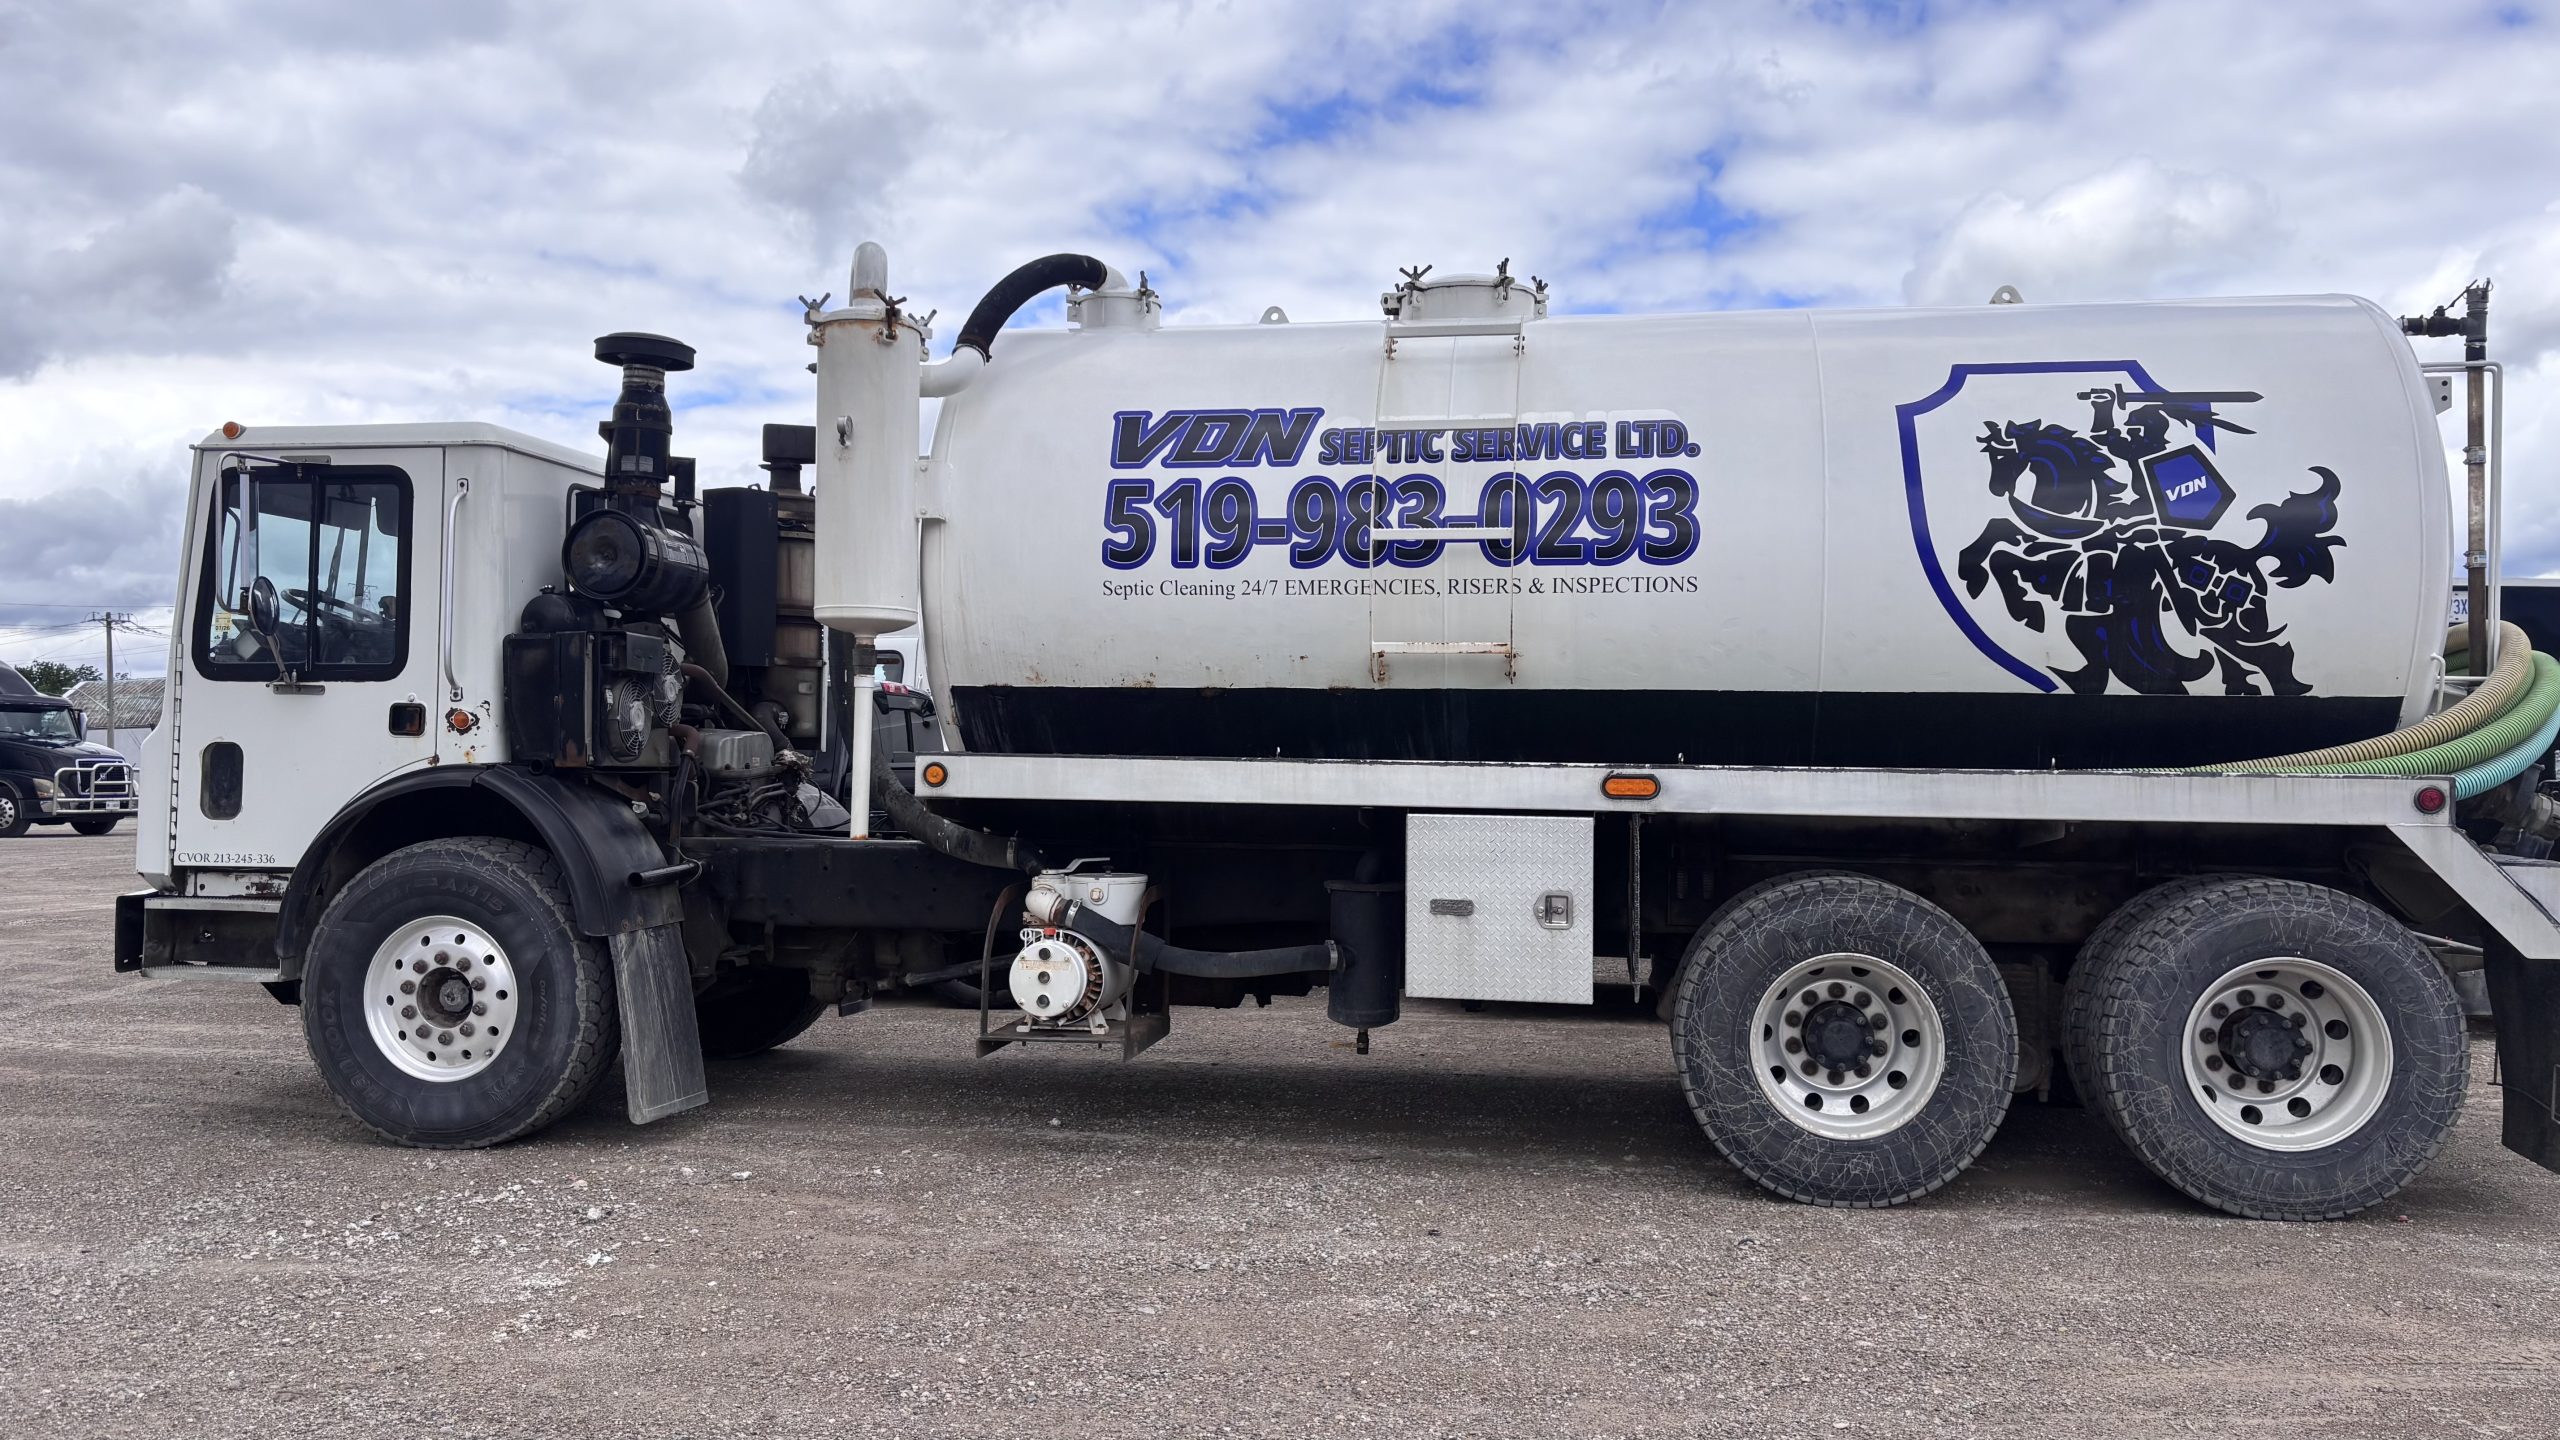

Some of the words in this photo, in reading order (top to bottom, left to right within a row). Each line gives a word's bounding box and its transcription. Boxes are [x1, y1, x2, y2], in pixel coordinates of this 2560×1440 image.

[1110, 406, 1325, 469] VDN
[1318, 426, 1444, 465] SEPTIC
[1451, 422, 1607, 462] SERVICE
[1615, 420, 1701, 459] LTD.
[2165, 475, 2207, 501] VDN
[1102, 469, 1701, 570] 519-983-0293
[1103, 580, 1153, 600] Septic
[1160, 580, 1235, 600] Cleaning
[1241, 580, 1278, 596] 24/7
[1285, 578, 1440, 597] EMERGENCIES,
[1448, 577, 1521, 595] RISERS
[1528, 577, 1546, 594] &
[1552, 576, 1698, 594] INSPECTIONS
[178, 853, 211, 863] CVOR
[213, 853, 275, 864] 213-245-336
